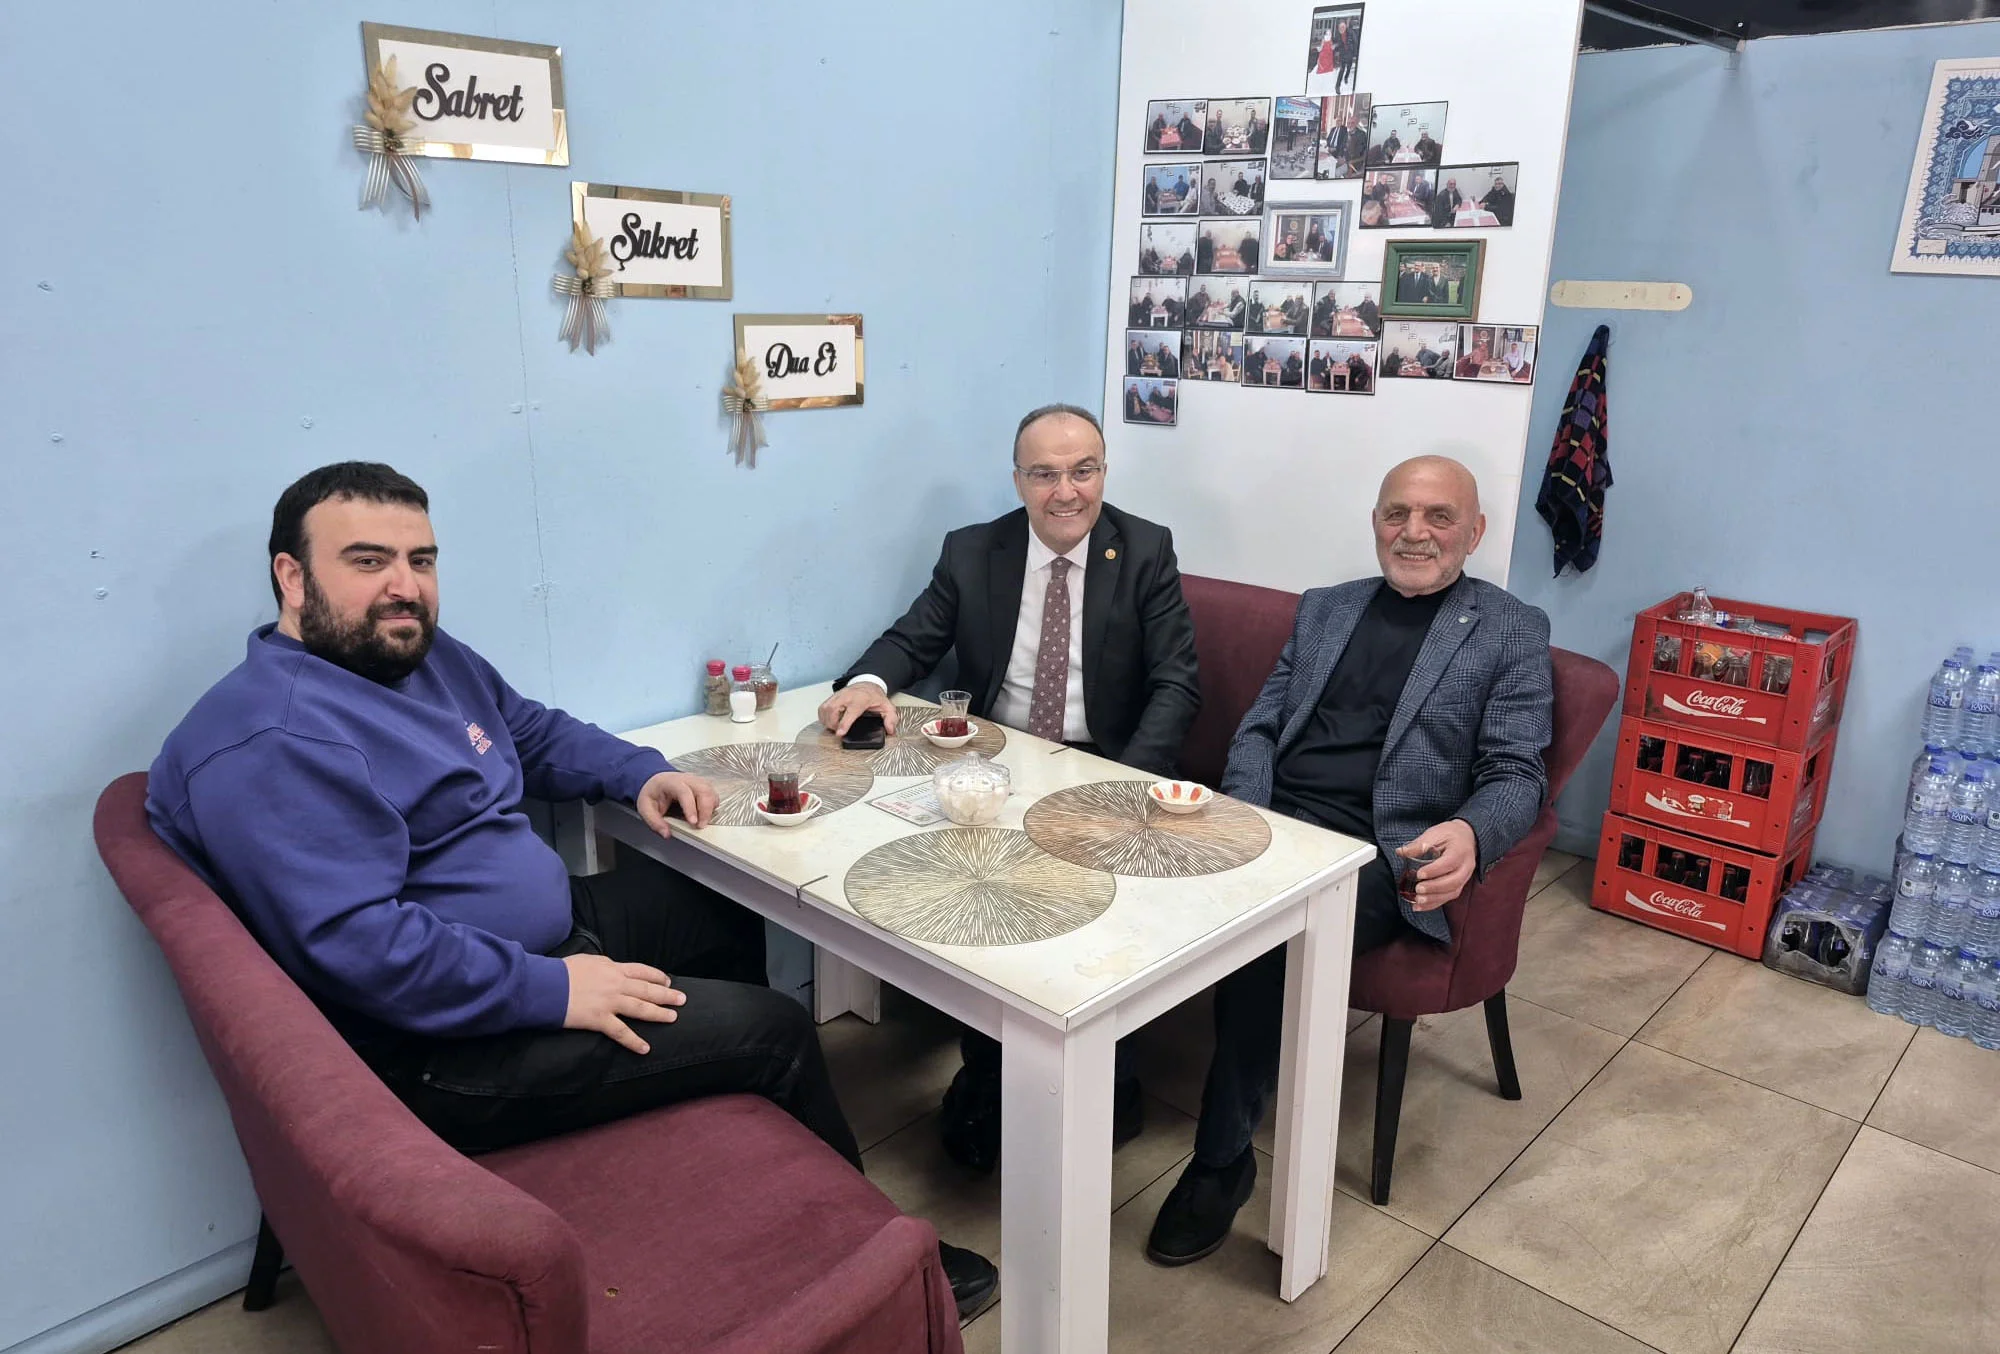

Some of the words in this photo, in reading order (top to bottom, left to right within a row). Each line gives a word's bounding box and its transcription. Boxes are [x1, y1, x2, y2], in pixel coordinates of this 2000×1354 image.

[412, 62, 525, 123] Sabret
[765, 342, 810, 379] Dua
[813, 341, 838, 377] Et
